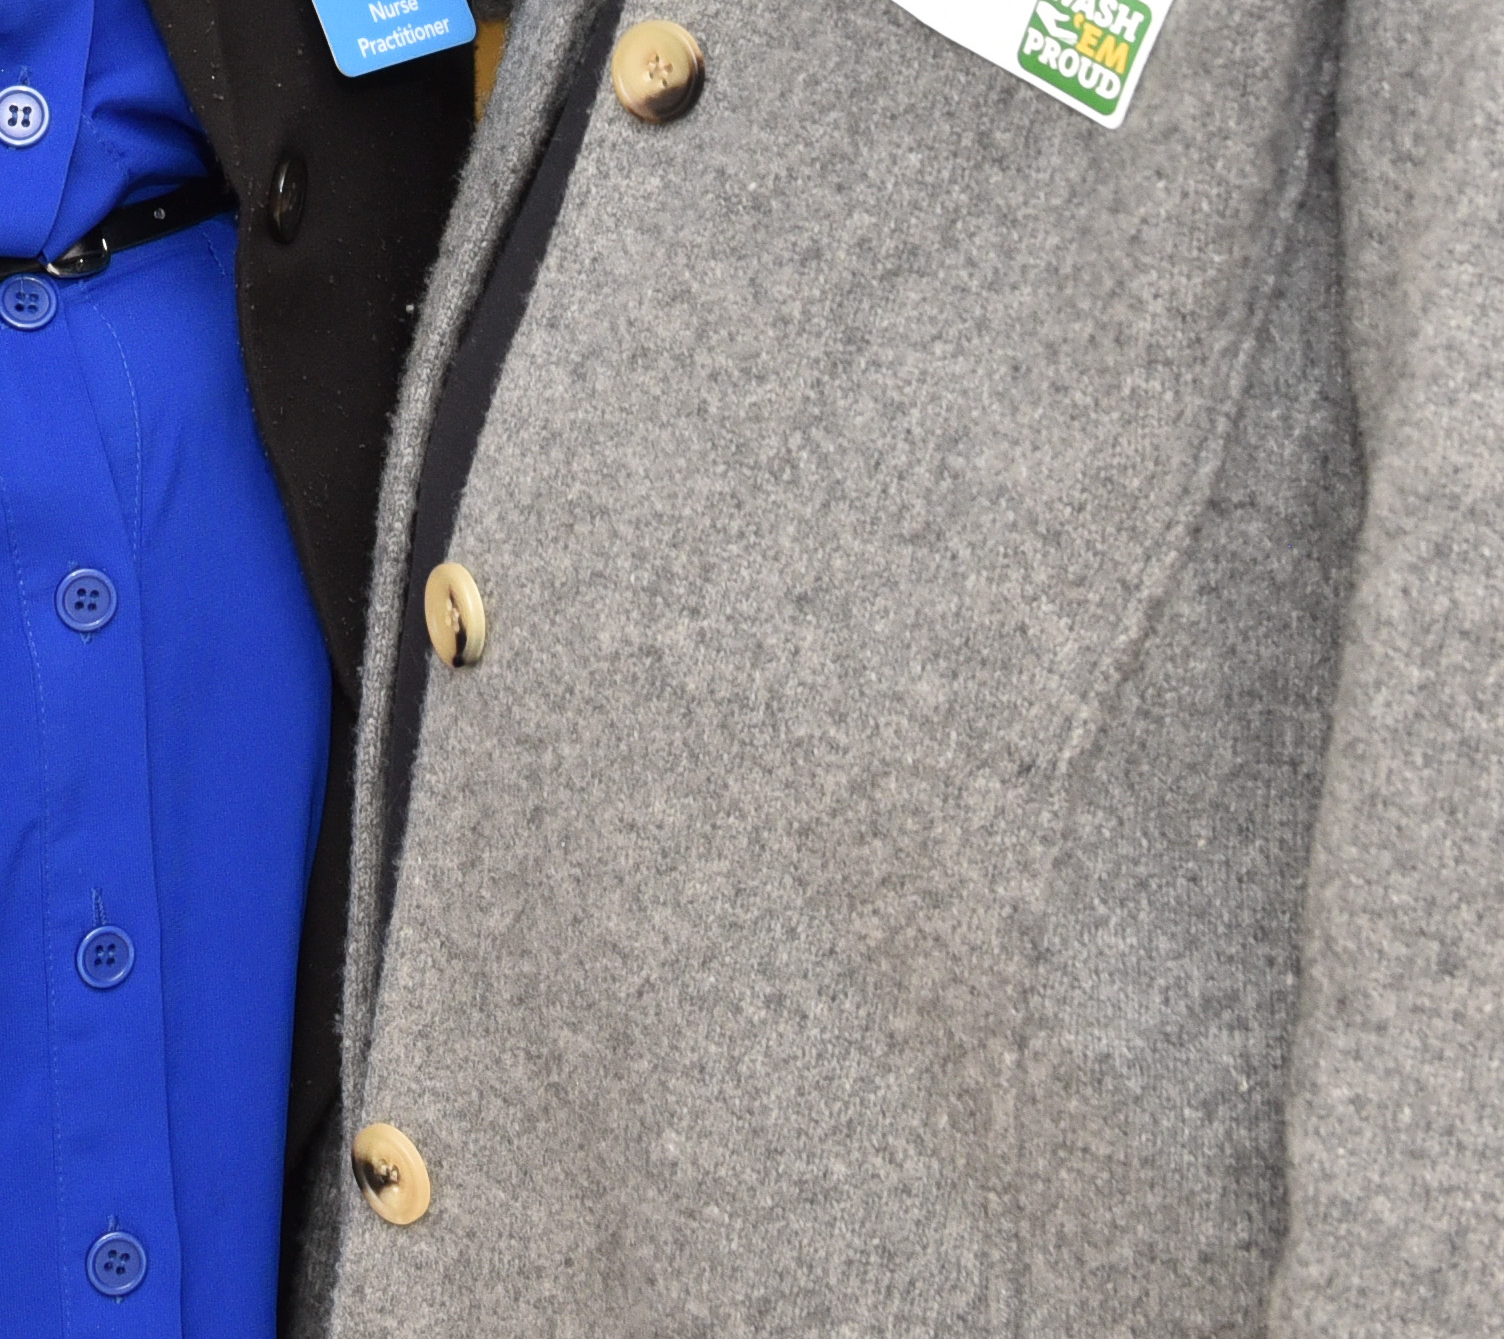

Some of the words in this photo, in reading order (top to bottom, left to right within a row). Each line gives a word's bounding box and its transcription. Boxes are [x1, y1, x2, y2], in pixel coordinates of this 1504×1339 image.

[357, 18, 450, 58] Practitioner
[1023, 26, 1121, 100] PROUD
[1073, 11, 1130, 75] 'EM
